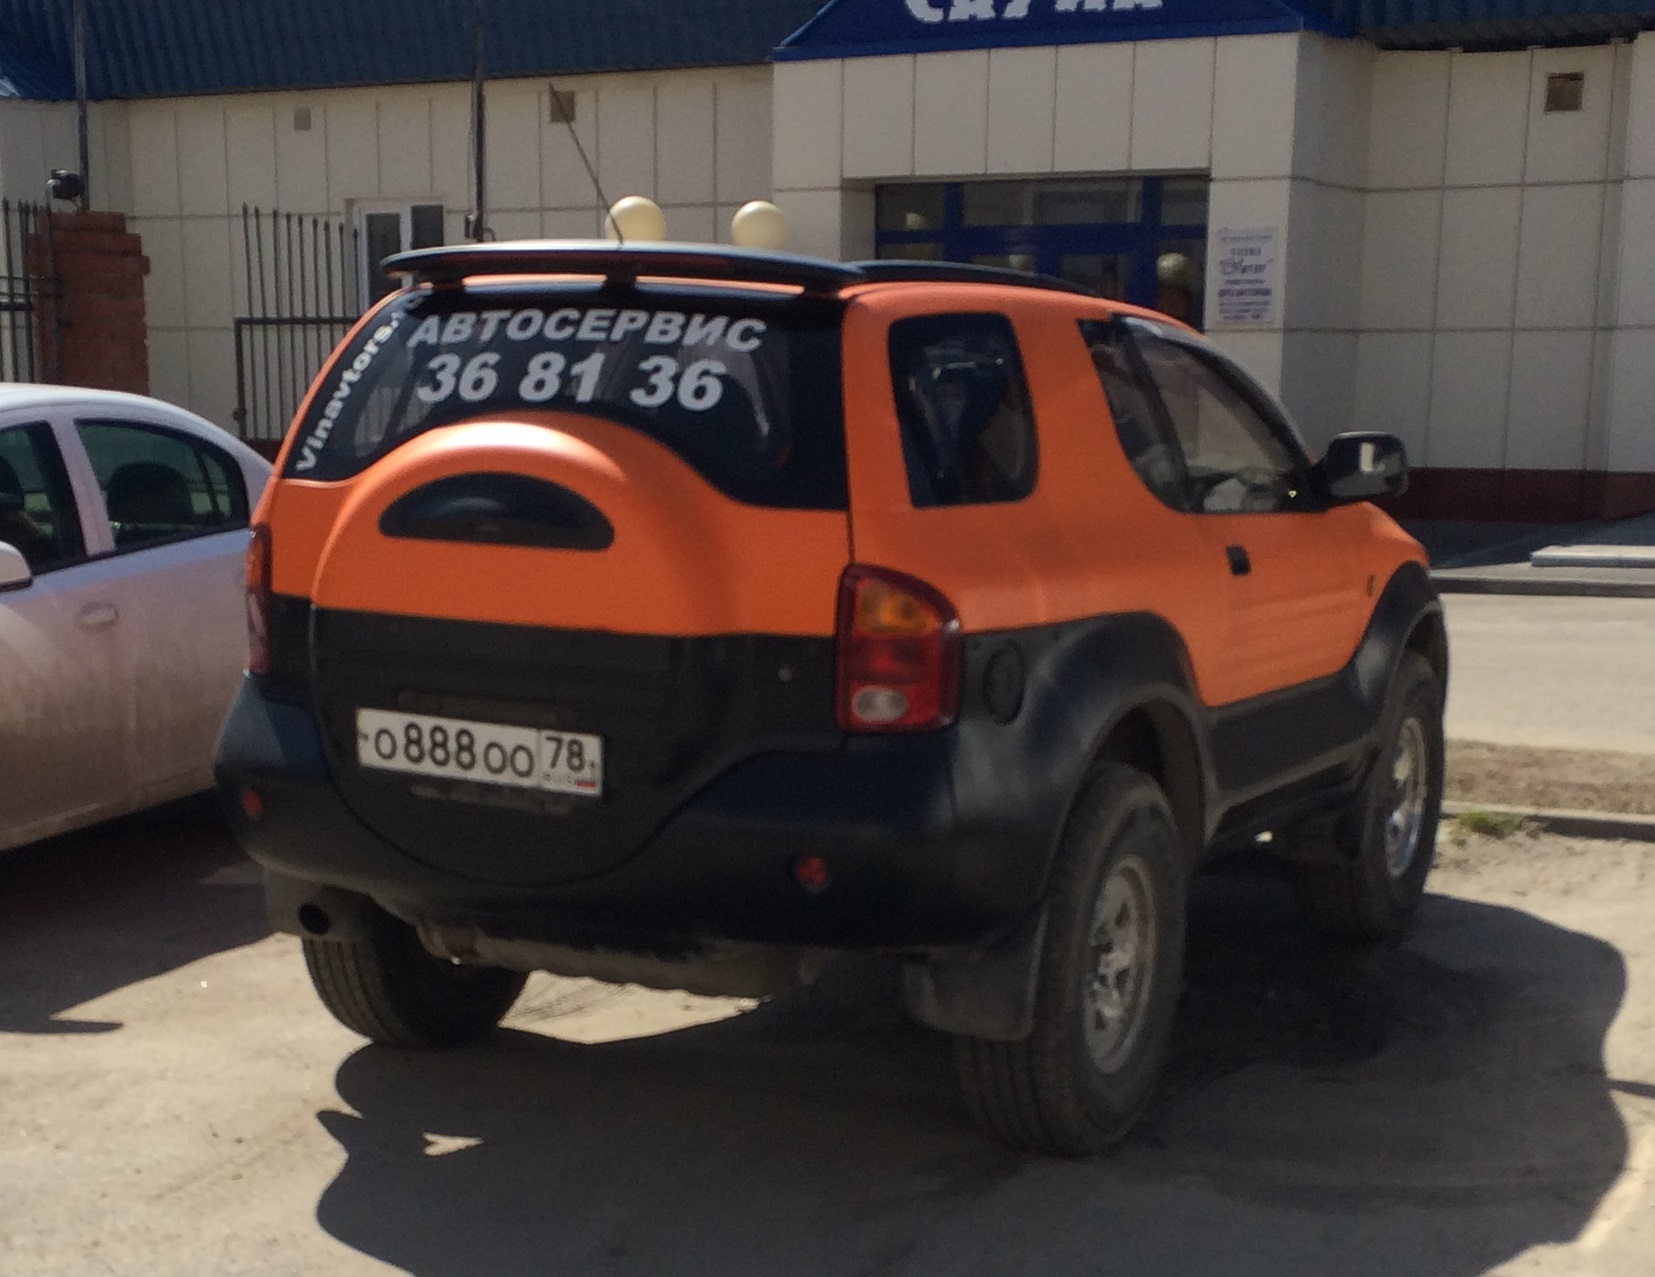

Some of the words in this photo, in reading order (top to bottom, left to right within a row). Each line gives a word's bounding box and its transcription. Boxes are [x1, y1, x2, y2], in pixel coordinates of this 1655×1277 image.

[405, 308, 766, 352] АВТОСЕРВИС
[417, 352, 500, 403] 36
[518, 351, 606, 403] 81
[629, 355, 727, 411] 36
[545, 736, 586, 773] 78
